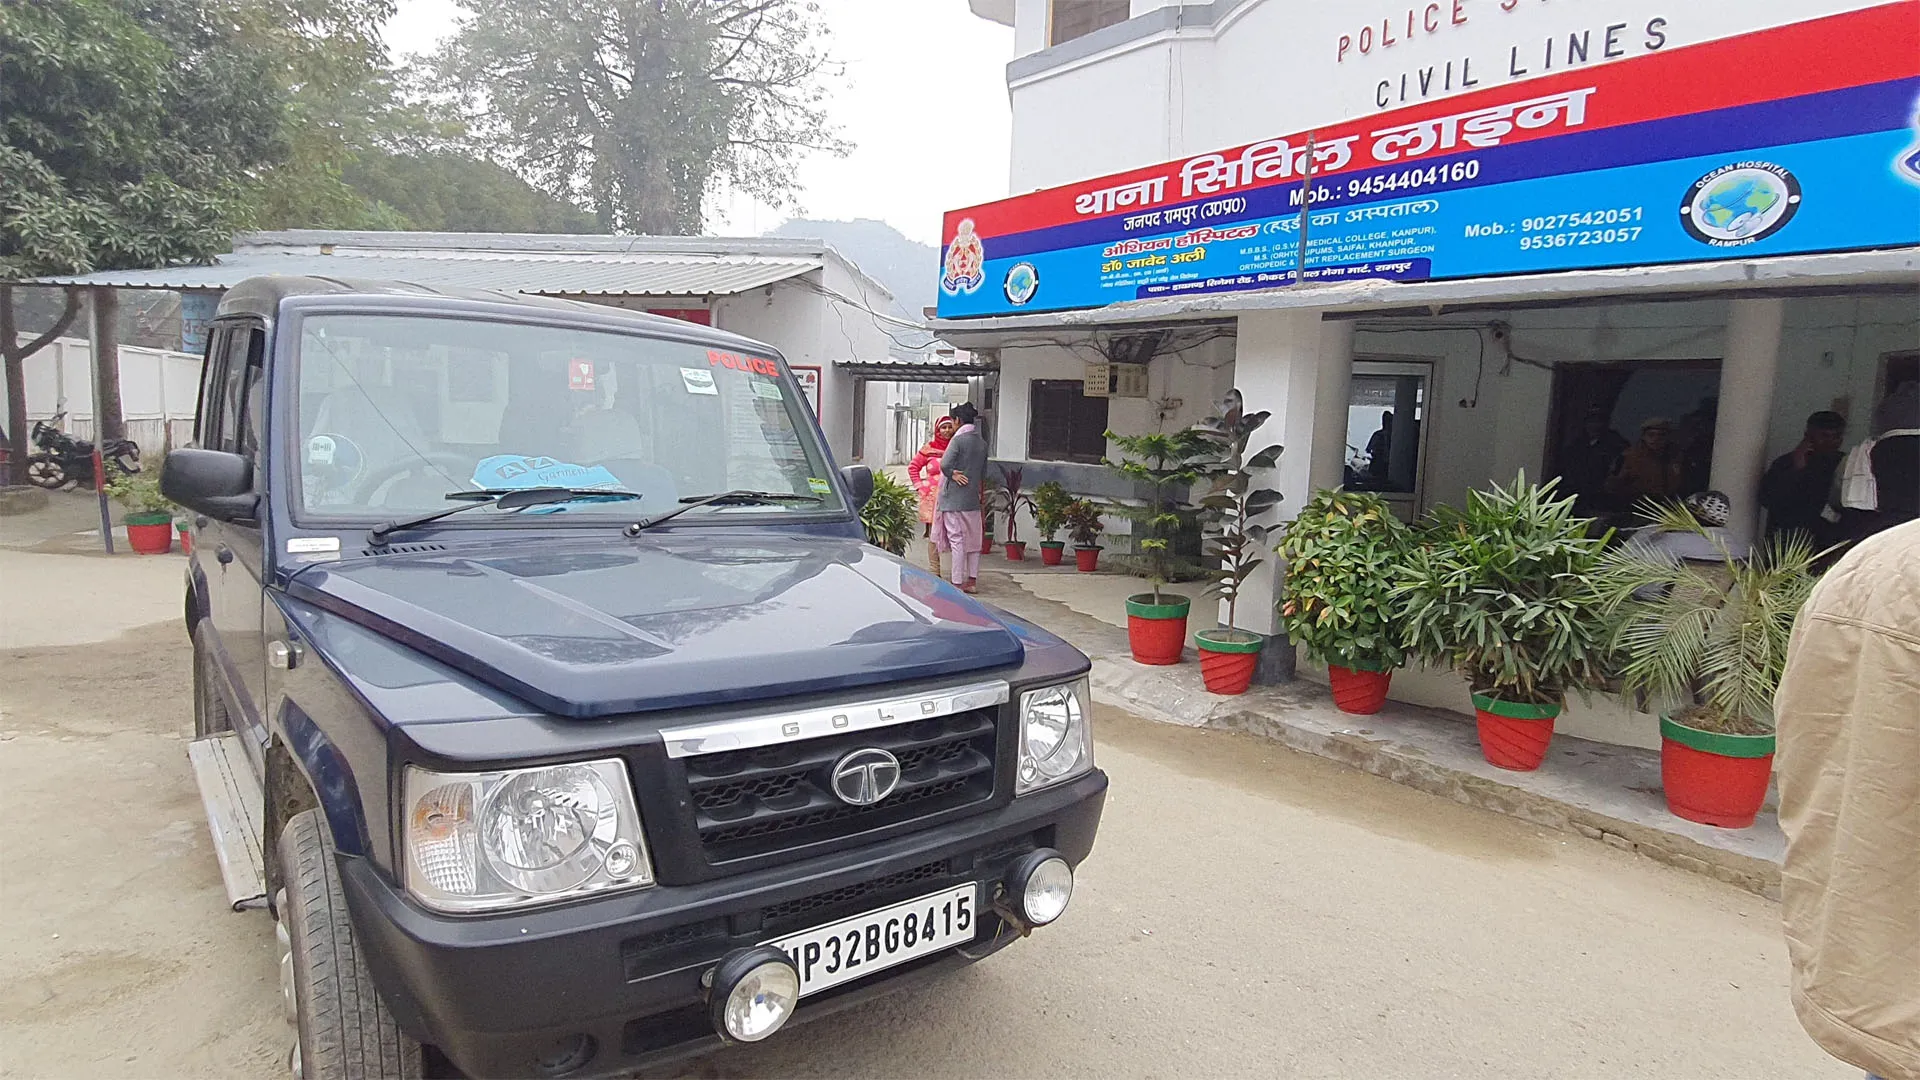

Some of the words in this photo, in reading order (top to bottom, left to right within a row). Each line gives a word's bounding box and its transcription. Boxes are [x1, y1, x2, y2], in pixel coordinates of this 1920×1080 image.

[1337, 2, 1468, 62] POLICE
[1376, 58, 1478, 107] CIVIL
[1510, 17, 1667, 76] LINES
[1075, 175, 1167, 215] थाना
[1180, 135, 1360, 197] सिविल
[1370, 86, 1597, 159] लाइन
[1348, 159, 1480, 198] 9454404160
[1695, 164, 1734, 188] OCEAN
[1736, 160, 1789, 179] HOSPITAL
[1103, 238, 1171, 257] ओशियन
[1175, 223, 1260, 248] हॉस्पिटल
[1310, 212, 1340, 226] का
[1345, 199, 1439, 223] अस्पताल)
[1123, 211, 1160, 231] जनपद
[1164, 205, 1197, 226] रामपुर
[1465, 221, 1515, 237] Mob.:
[1521, 206, 1643, 232] 9027542051
[1307, 237, 1342, 247] MEDICAL
[1519, 226, 1643, 250] 9536723057
[1708, 237, 1756, 247] RAMPUR
[1170, 246, 1206, 263] अली
[1239, 260, 1287, 271] ORTHOPEDIC
[1322, 250, 1385, 263] REPLACEMENT
[1388, 245, 1435, 256] SURGEON
[706, 350, 780, 377] POLICE
[781, 701, 937, 737] GOLD
